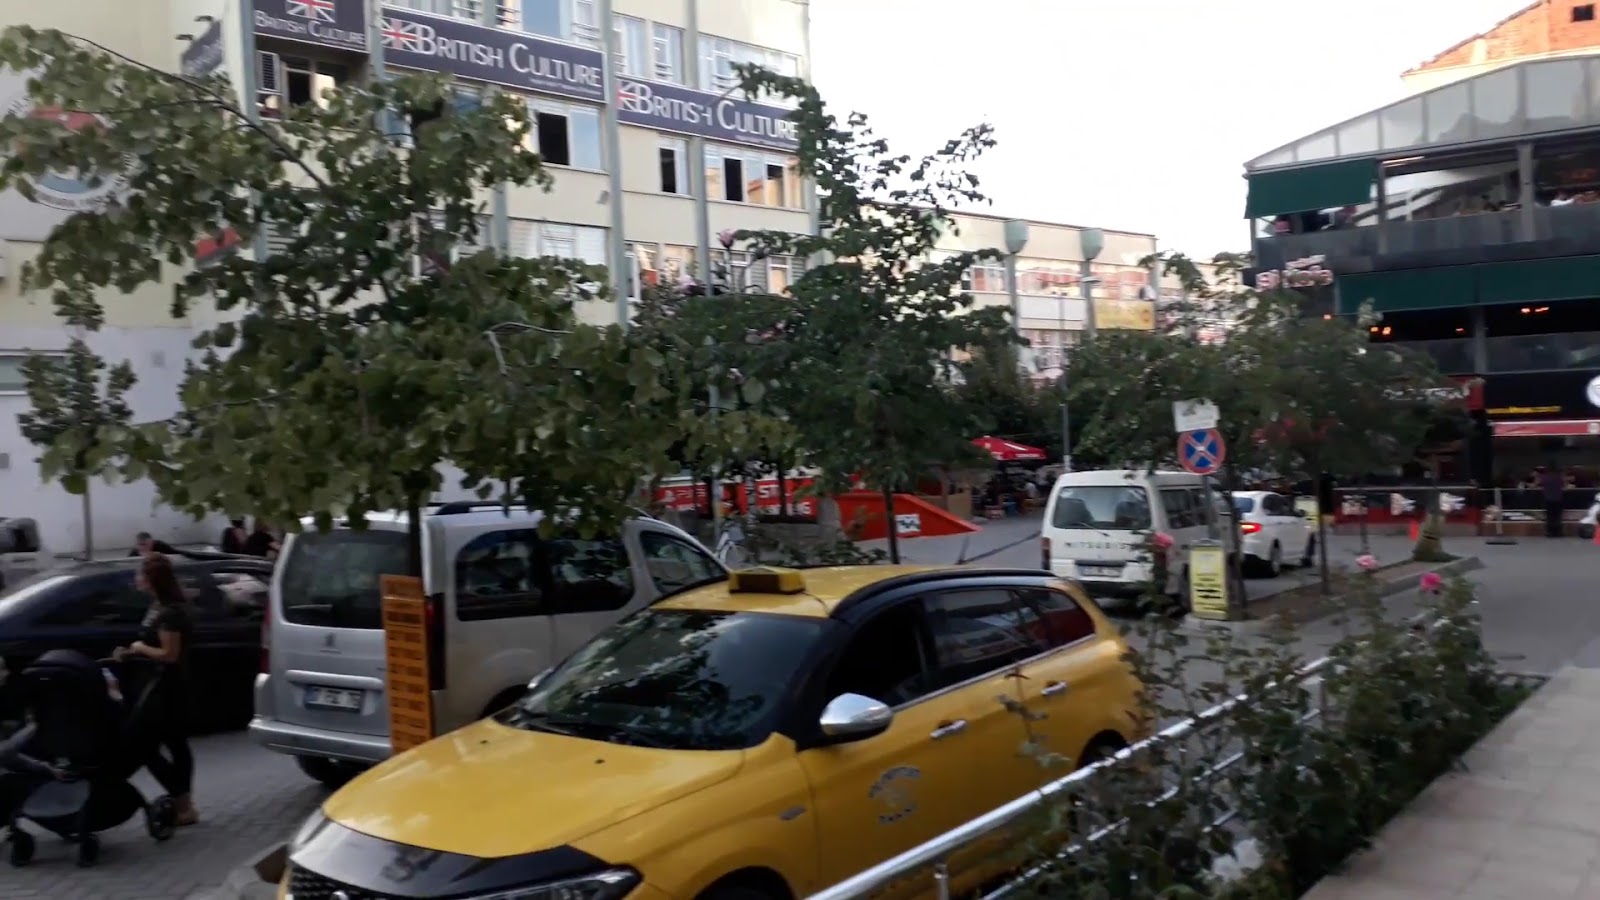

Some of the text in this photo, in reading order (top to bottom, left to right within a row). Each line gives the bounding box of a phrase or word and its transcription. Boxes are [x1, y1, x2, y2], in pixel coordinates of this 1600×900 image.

[308, 20, 366, 45] CULTURE
[417, 23, 602, 87] BRITISH CULTURE
[634, 83, 799, 142] BRITISH CULTURE
